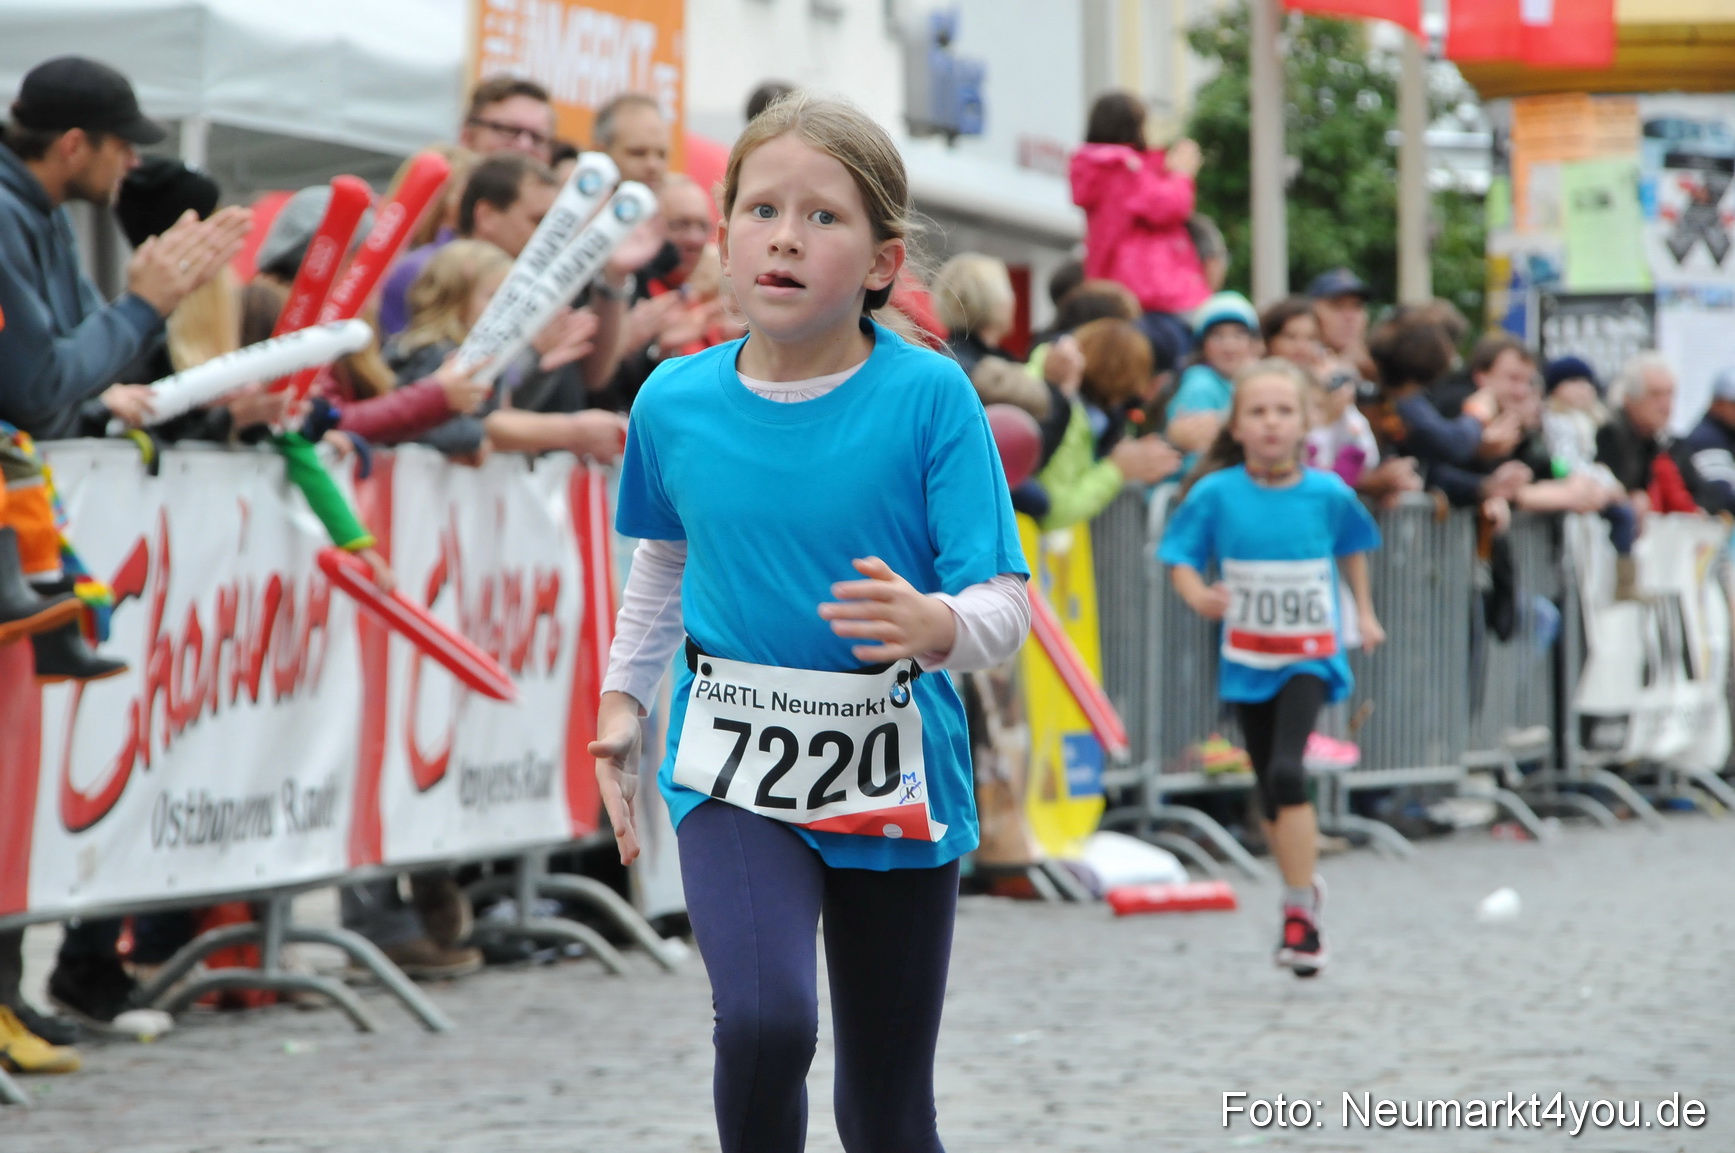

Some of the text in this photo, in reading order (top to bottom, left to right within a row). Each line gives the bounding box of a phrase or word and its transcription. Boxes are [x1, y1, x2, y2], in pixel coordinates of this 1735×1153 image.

[1238, 588, 1326, 625] 7096
[695, 679, 886, 717] PARTL Neumarkt
[711, 717, 901, 810] 7220
